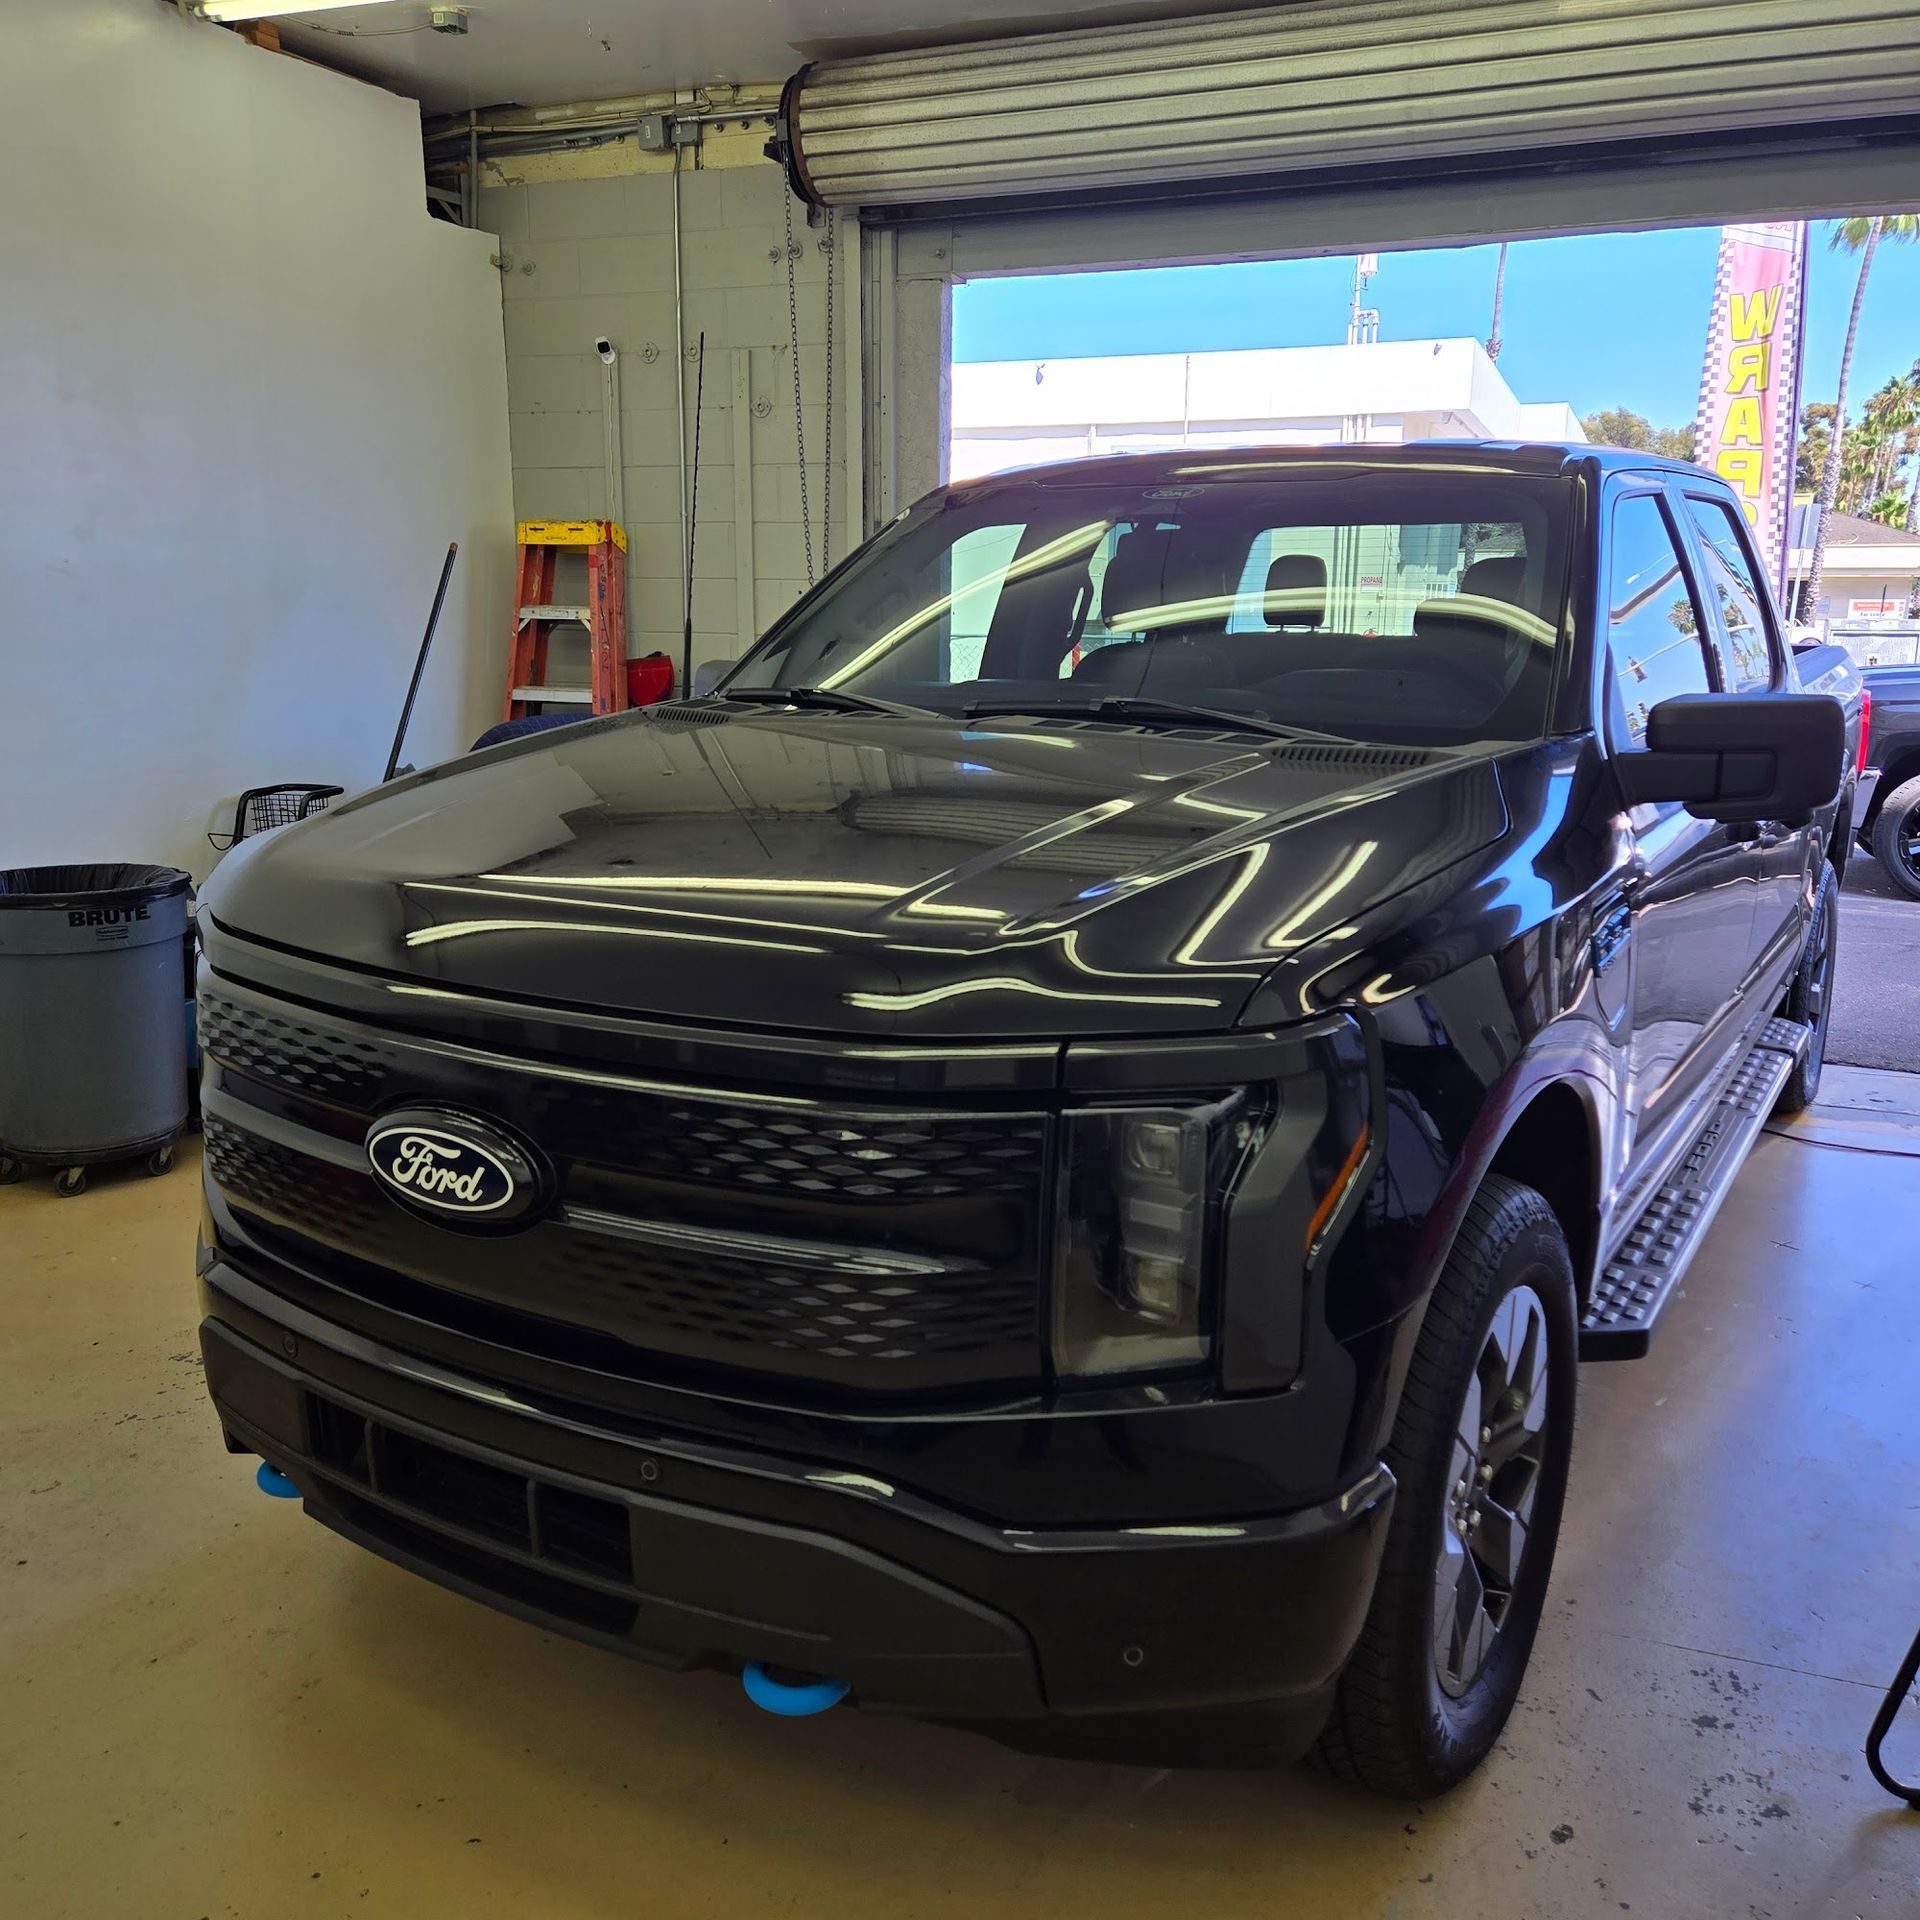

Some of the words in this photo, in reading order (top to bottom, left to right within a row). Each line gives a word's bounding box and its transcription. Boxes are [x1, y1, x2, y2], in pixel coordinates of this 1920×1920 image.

[1360, 576, 1383, 584] PROPANE
[68, 905, 151, 927] BRUTE
[392, 1136, 485, 1202] Ford
